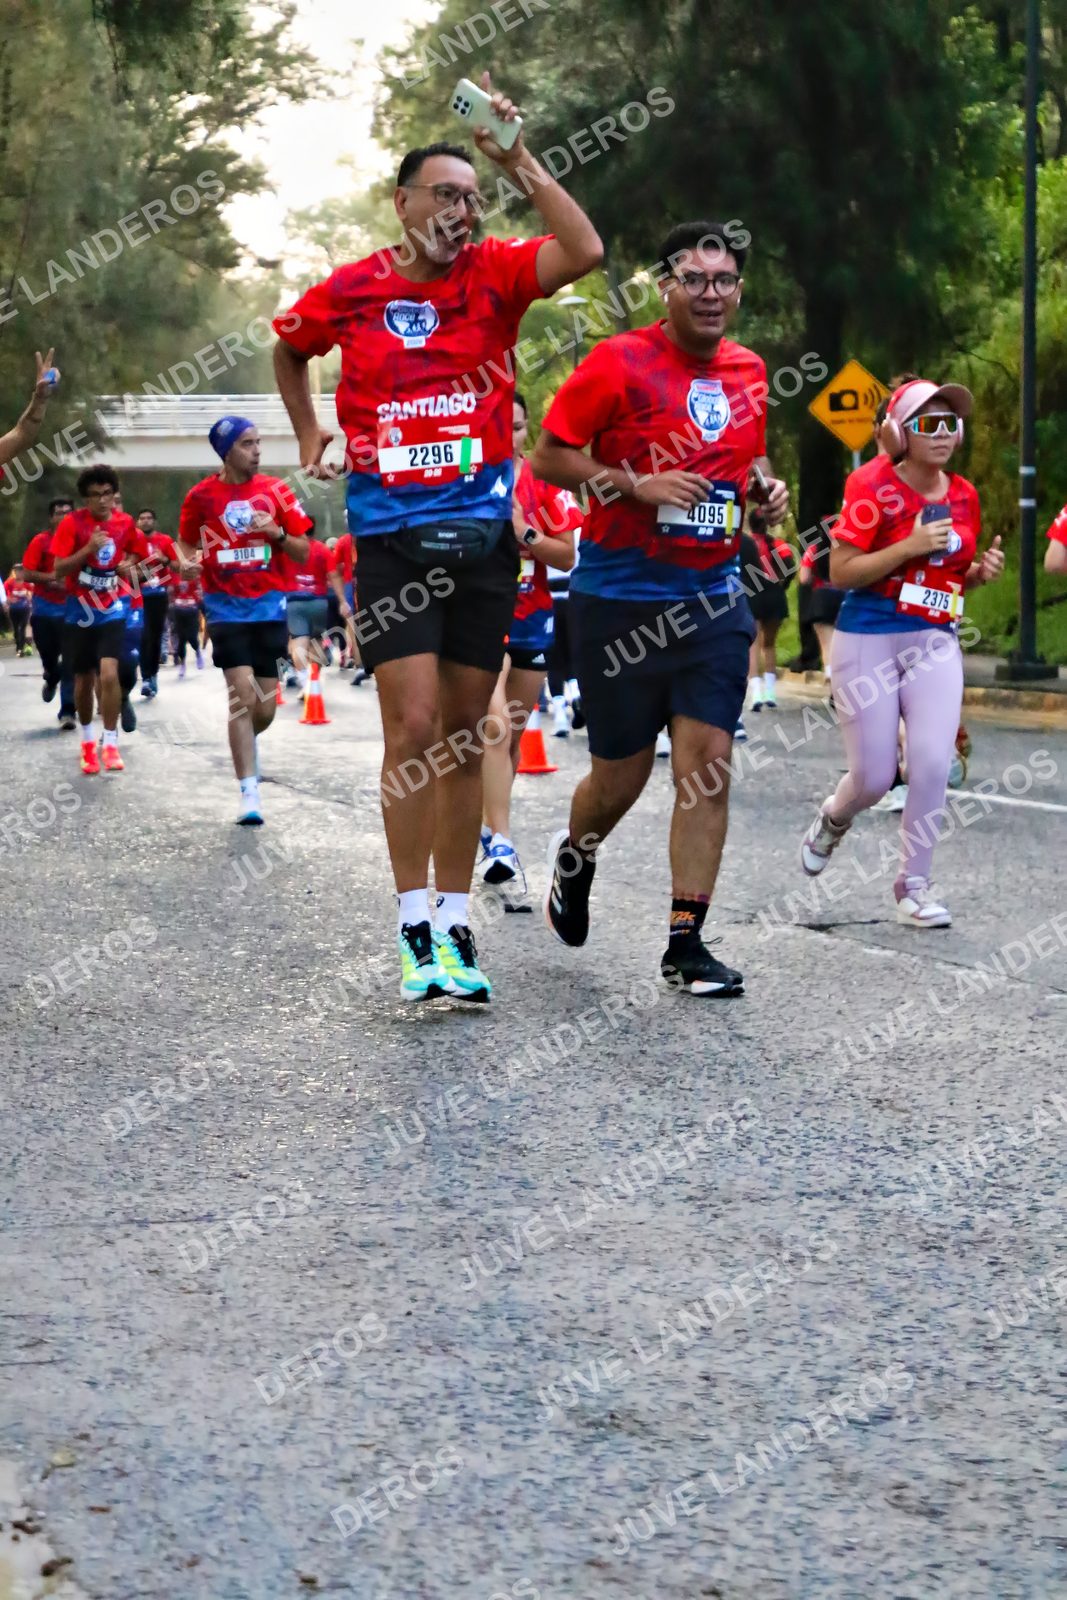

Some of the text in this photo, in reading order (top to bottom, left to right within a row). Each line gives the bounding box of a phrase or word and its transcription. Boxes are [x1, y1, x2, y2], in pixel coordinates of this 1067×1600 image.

[376, 392, 476, 422] SANTIAGO
[409, 444, 454, 467] 2296
[687, 504, 724, 525] 4095
[234, 548, 255, 561] 3104
[922, 589, 950, 610] 2375
